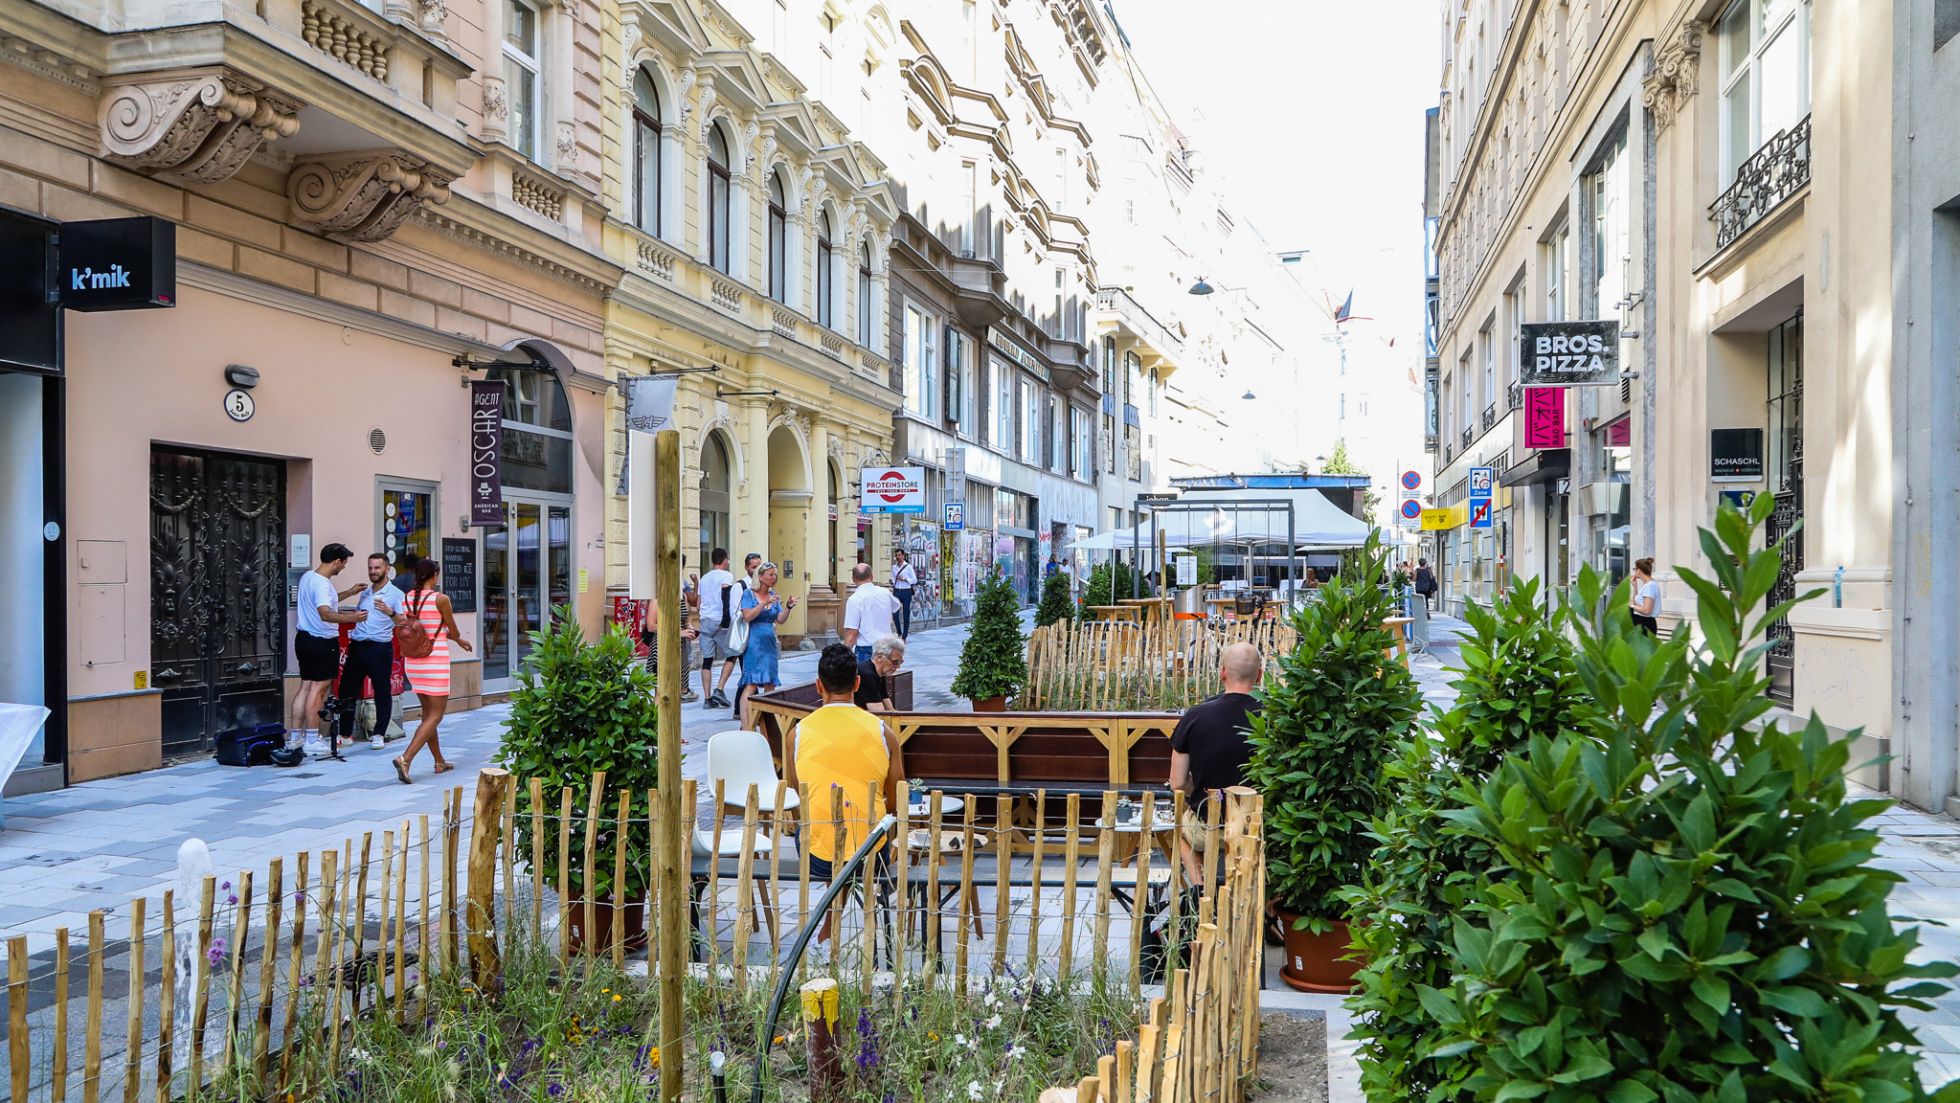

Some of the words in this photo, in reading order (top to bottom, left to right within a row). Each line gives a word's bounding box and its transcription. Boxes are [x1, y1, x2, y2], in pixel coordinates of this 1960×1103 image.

[1536, 334, 1610, 354] BROS.
[1536, 354, 1606, 373] PIZZA
[236, 394, 244, 413] 5
[474, 392, 500, 406] AGENT
[1533, 387, 1551, 440] バオバ
[1552, 409, 1560, 426] BAR
[473, 408, 498, 478] OSCAR
[1552, 426, 1560, 446] BAO
[866, 481, 918, 489] PROTEINSTORE
[448, 564, 463, 574] NEED
[463, 563, 472, 574] ICE
[445, 576, 457, 587] FOR
